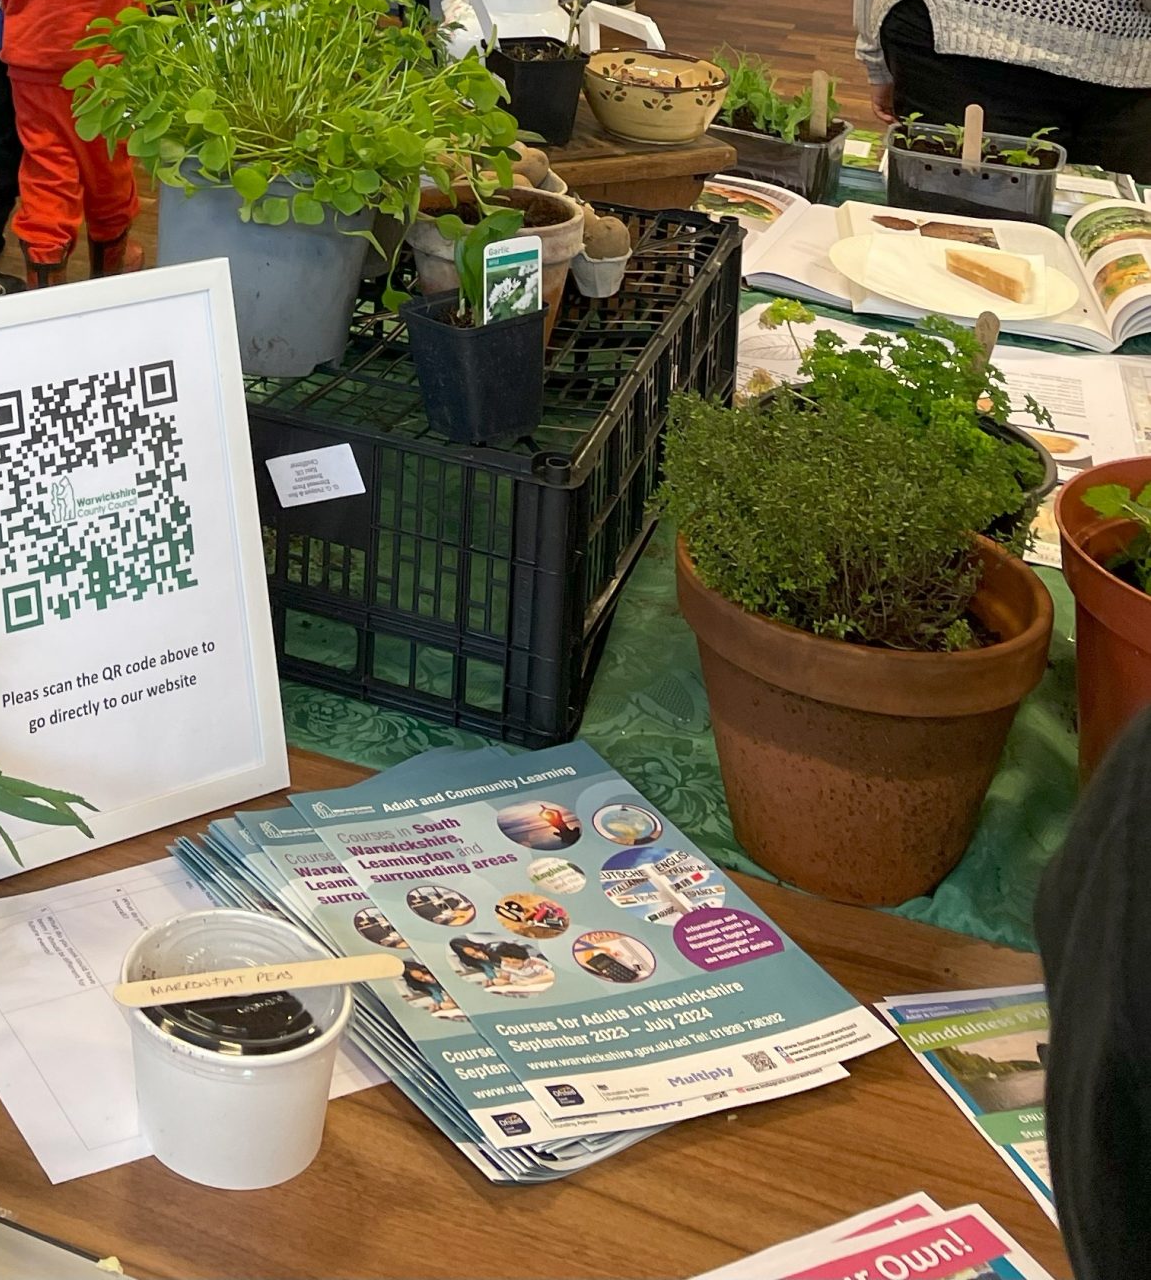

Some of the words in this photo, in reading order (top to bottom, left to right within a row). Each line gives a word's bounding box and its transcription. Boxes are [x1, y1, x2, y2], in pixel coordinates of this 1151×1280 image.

[77, 488, 136, 507] Warwickshire
[78, 505, 106, 519] County
[107, 497, 138, 511] Council
[2, 688, 39, 708] Pleas
[43, 679, 73, 698] scan
[76, 671, 99, 689] the
[102, 664, 123, 681] QR
[125, 655, 157, 675] code
[160, 644, 199, 666] above
[201, 640, 215, 653] to
[28, 717, 46, 734] go
[50, 700, 100, 725] directly
[103, 696, 118, 710] to
[121, 687, 144, 705] our
[146, 673, 197, 698] website
[382, 799, 419, 813] Adult
[420, 791, 444, 808] and
[445, 775, 519, 801] Community
[518, 765, 577, 787] Learning
[337, 829, 396, 845] Courses
[399, 826, 410, 836] in
[412, 817, 461, 835] South
[347, 833, 464, 858] Warwickshire,
[358, 850, 454, 872] Leamington
[457, 842, 484, 857] and
[370, 861, 471, 884] surrounding
[472, 852, 518, 870] areas
[495, 1018, 558, 1038] Courses
[557, 1016, 579, 1030] for
[581, 1007, 630, 1027] Adults
[628, 1003, 642, 1017] in
[645, 980, 744, 1013] Warwickshire
[508, 1032, 590, 1054] September
[590, 1026, 629, 1043] 2023
[645, 1018, 675, 1034] July
[675, 1006, 713, 1026] 2024
[909, 1015, 1014, 1047] Mindfulness
[526, 1037, 691, 1070] www.warwickshire.gov.uk/acl
[692, 1032, 711, 1043] Tel:
[667, 1066, 734, 1088] Multiply
[875, 1227, 973, 1280] Own!
